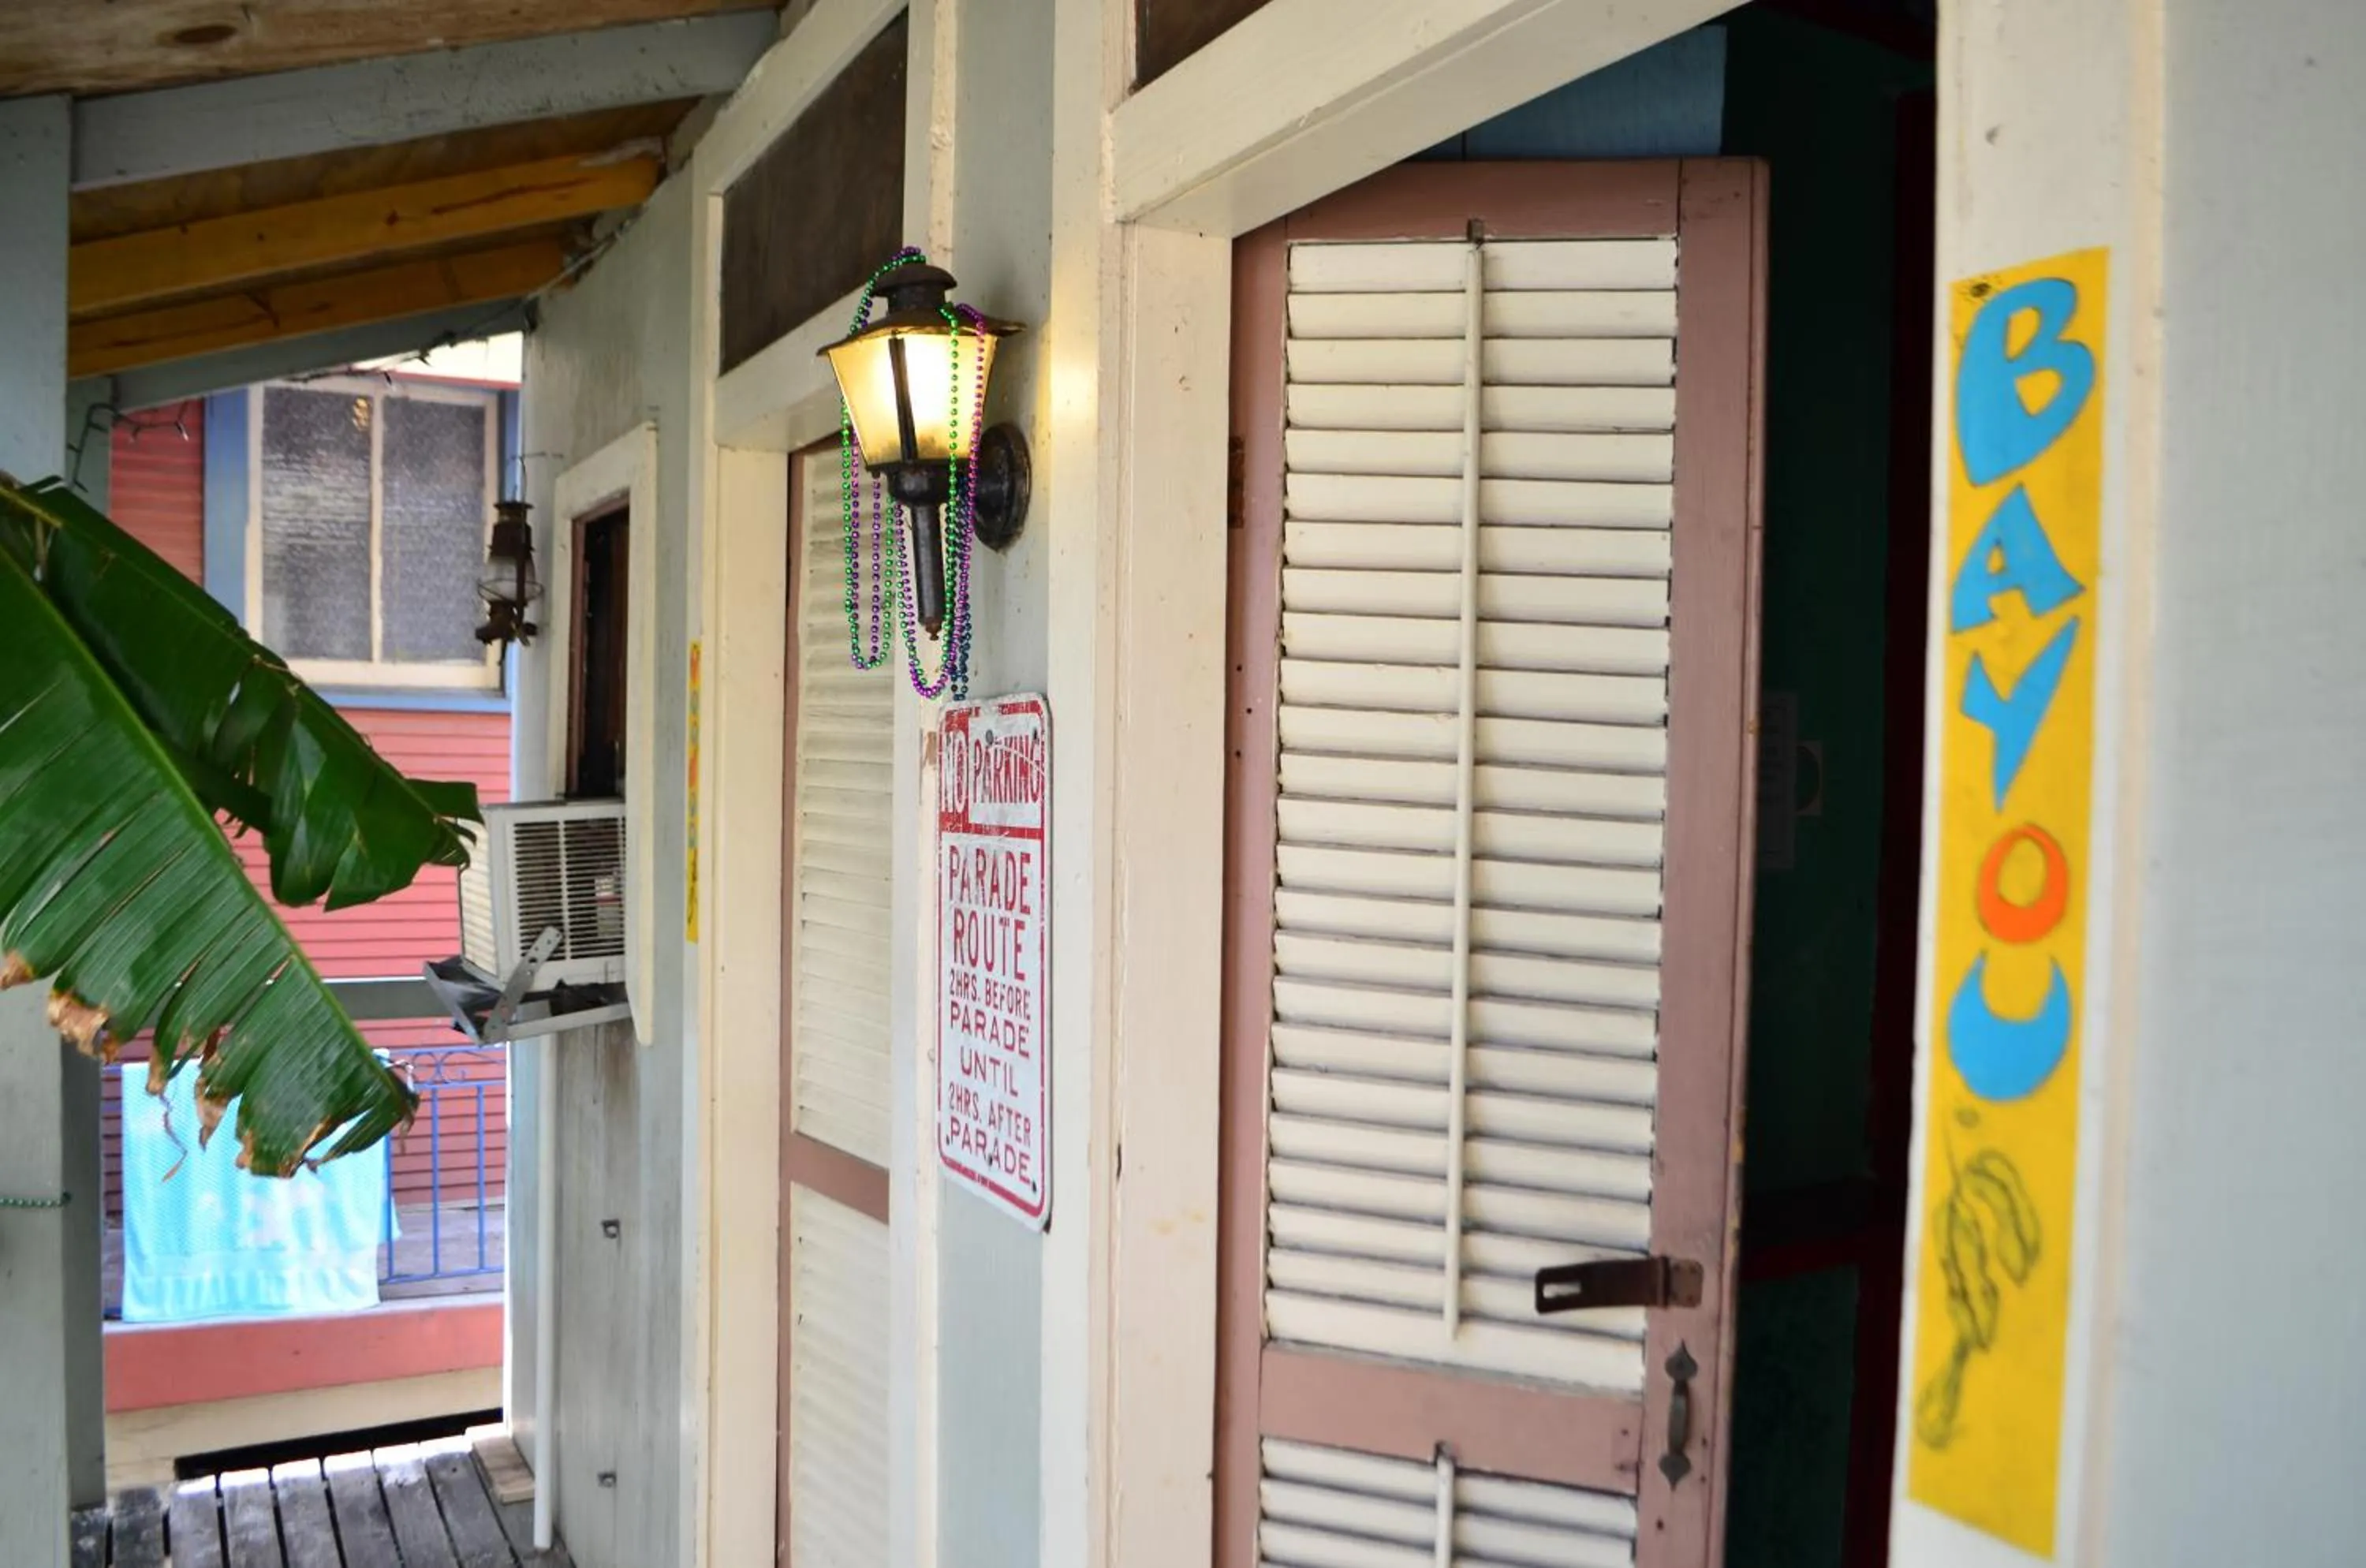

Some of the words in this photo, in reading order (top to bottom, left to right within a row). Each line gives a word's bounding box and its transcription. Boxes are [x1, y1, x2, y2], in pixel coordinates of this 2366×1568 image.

[1949, 277, 2095, 1103] BAYOU
[942, 728, 968, 814] NO
[972, 734, 1039, 804] PARKING
[950, 845, 1031, 915] PARADE
[953, 908, 1026, 980] ROUTE
[949, 969, 981, 1002] 2HRS.
[985, 978, 1031, 1022] BEFORE
[950, 1001, 1030, 1059] PARADE
[960, 1046, 1018, 1097] UNTIL
[949, 1082, 982, 1124] 2HRS.
[988, 1102, 1031, 1147] AFTER
[950, 1117, 1031, 1183] PARADE
